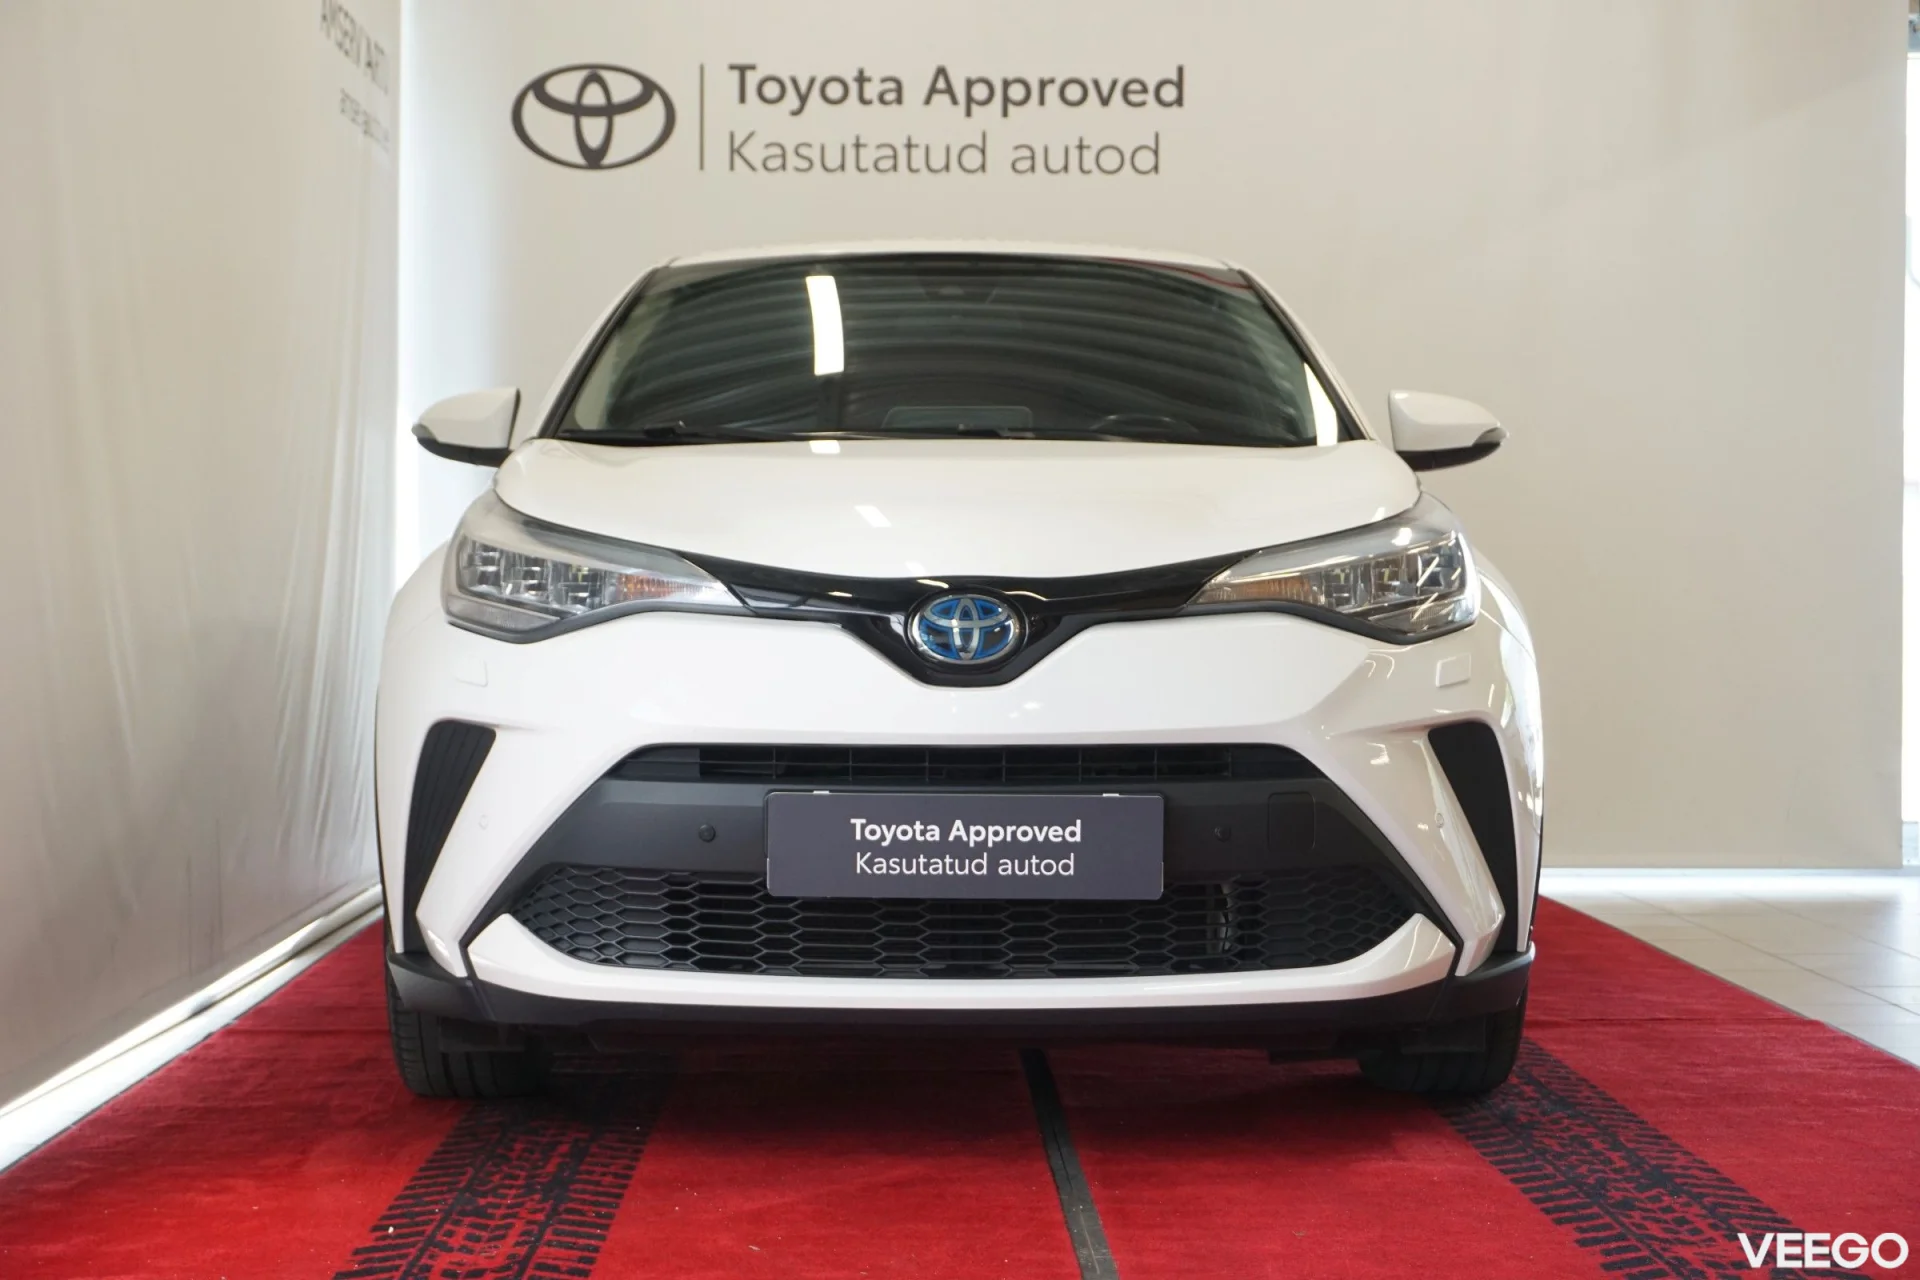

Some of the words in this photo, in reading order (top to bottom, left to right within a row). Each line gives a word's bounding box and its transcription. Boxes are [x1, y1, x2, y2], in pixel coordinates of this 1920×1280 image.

[727, 63, 904, 117] Toyota
[922, 64, 1185, 118] Approved
[728, 130, 987, 175] Kasutatud
[1010, 131, 1161, 176] autod
[850, 818, 941, 847] Toyota
[947, 819, 1082, 848] Approved
[856, 851, 988, 876] Kasutatud
[997, 852, 1075, 876] autod
